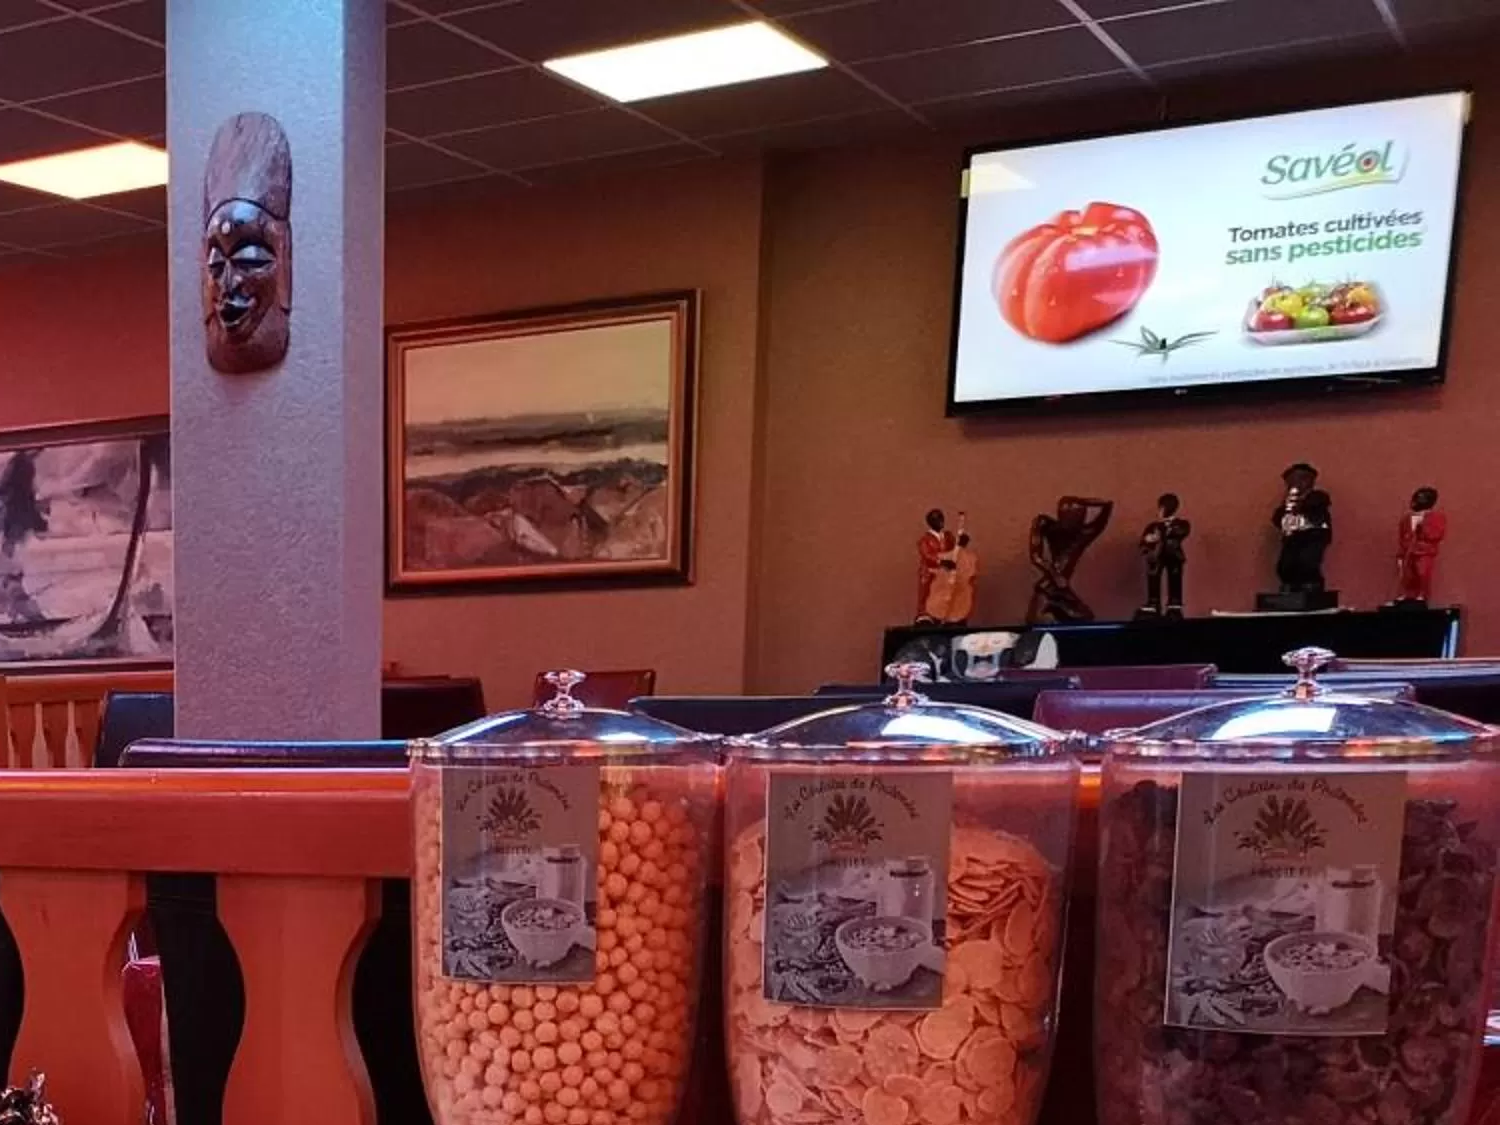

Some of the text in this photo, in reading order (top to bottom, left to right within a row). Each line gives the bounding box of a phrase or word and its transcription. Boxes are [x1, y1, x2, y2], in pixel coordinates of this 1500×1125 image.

[1260, 139, 1394, 186] Savéol
[1228, 208, 1424, 243] Tomates cultivées
[1225, 229, 1424, 266] sans pesticides
